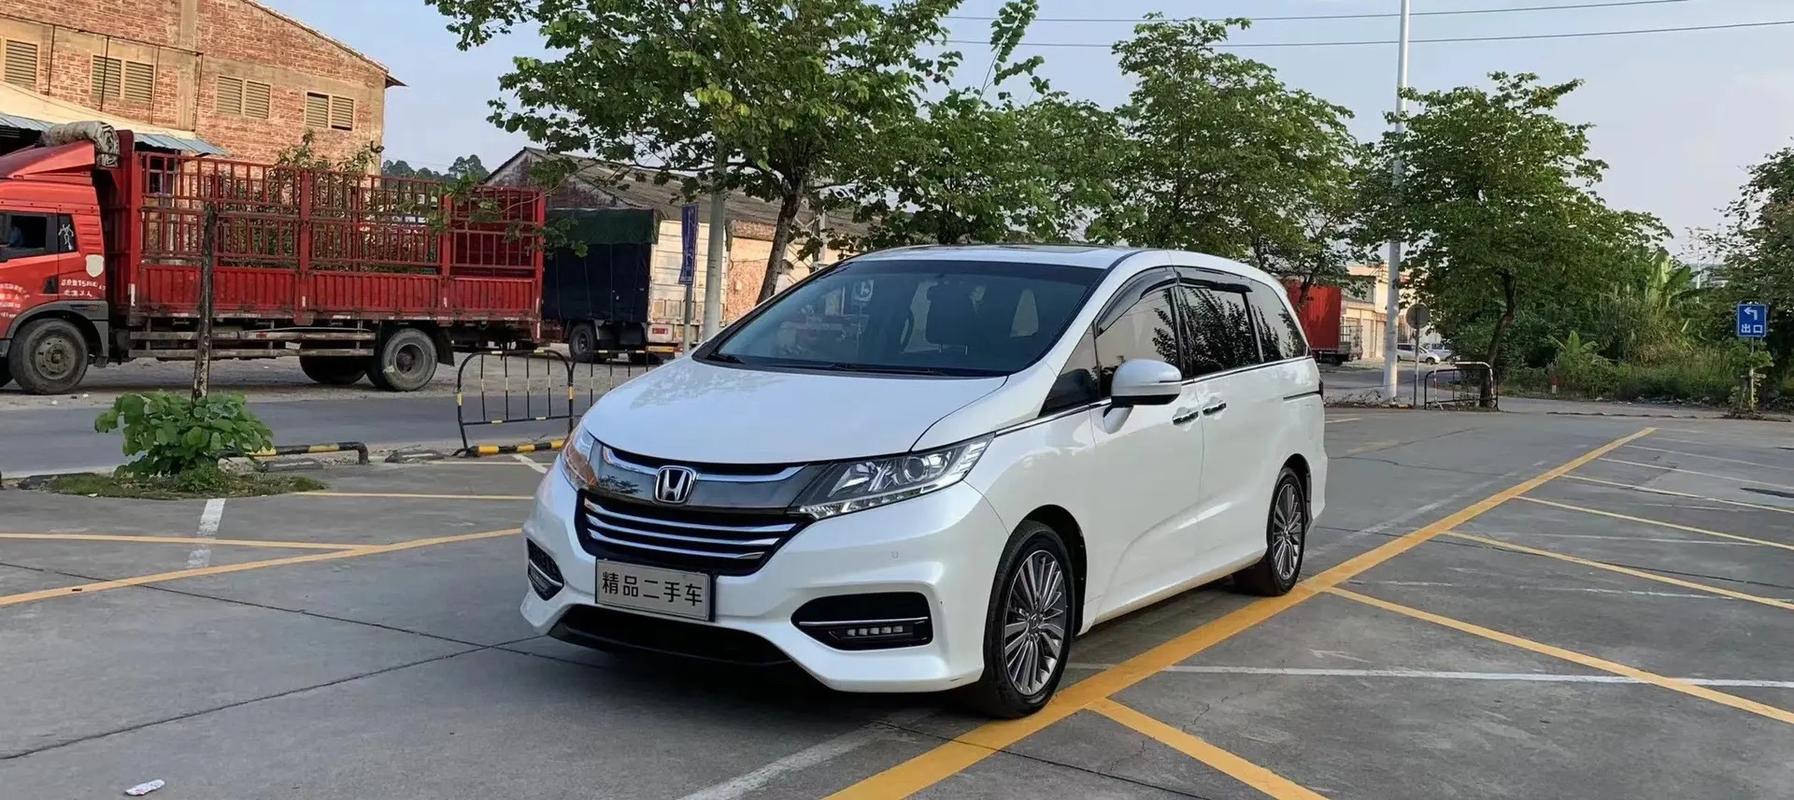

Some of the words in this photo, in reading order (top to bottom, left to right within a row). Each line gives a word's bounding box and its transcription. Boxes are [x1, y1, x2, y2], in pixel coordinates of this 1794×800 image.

[1741, 323, 1763, 334] 出口
[602, 571, 703, 606] 精品二手车
